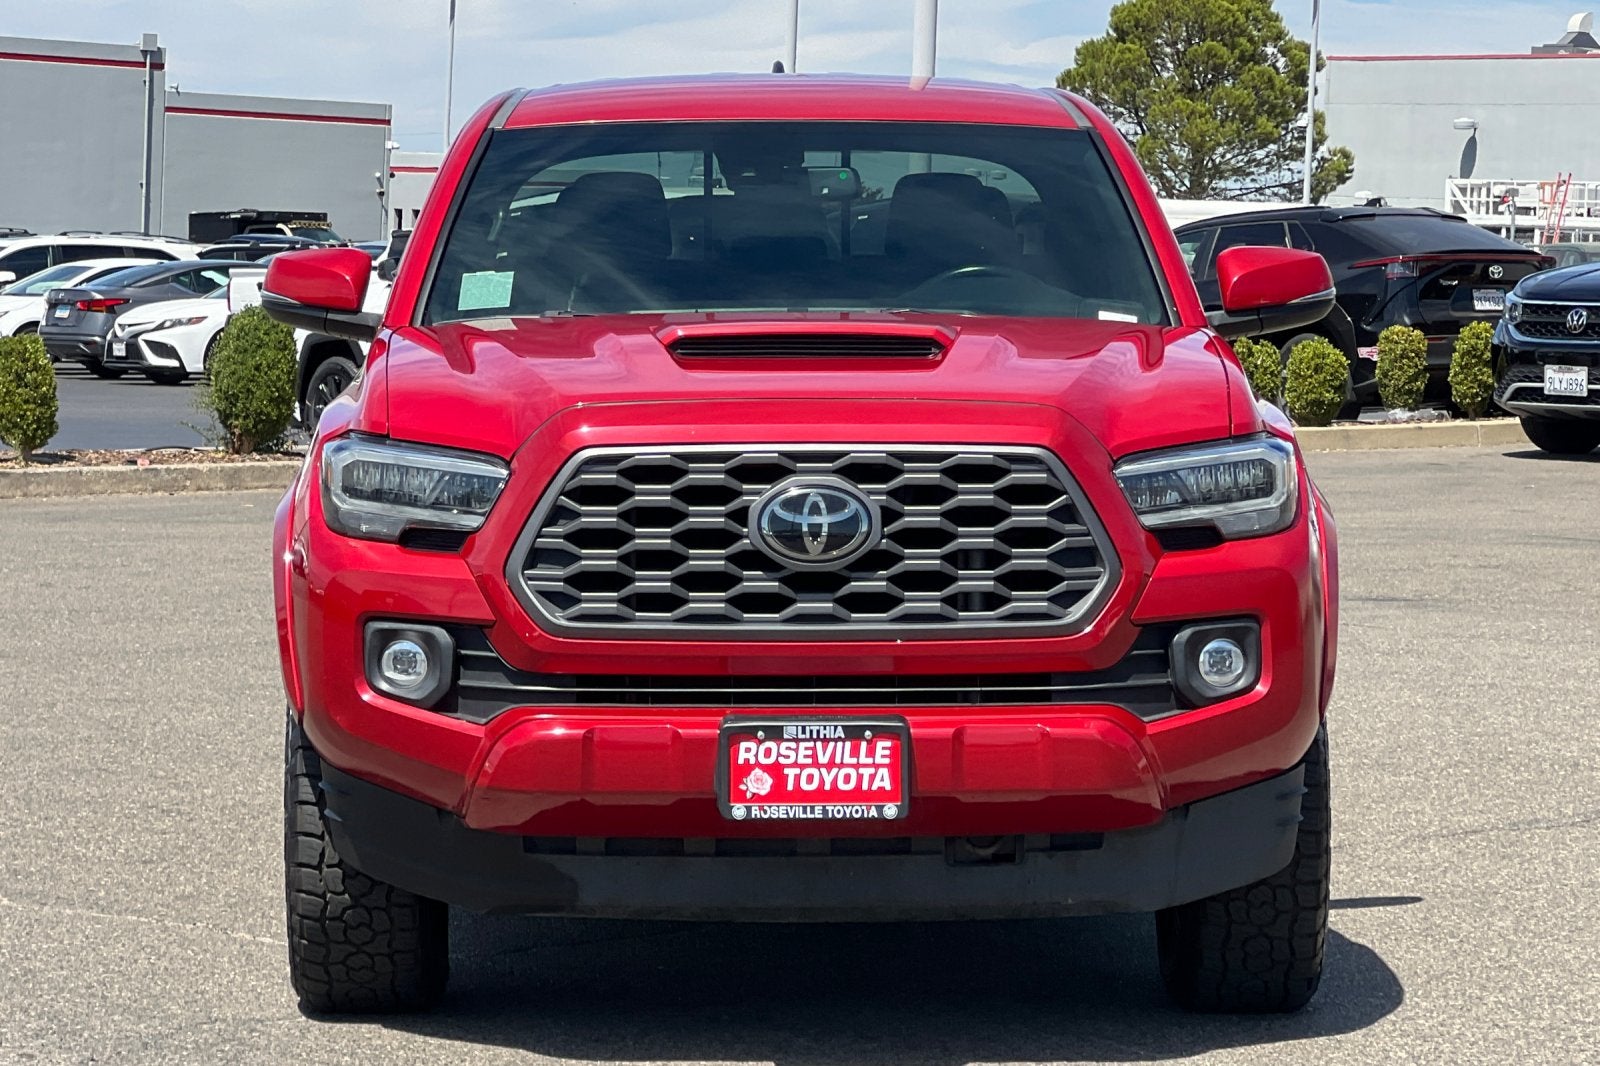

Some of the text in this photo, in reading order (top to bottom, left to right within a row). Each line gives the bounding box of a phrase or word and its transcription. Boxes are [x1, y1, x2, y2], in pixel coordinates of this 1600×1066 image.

[1548, 376, 1584, 391] 9LYJ896
[797, 726, 845, 739] LITHIA
[737, 741, 892, 765] ROSEVILLE
[783, 767, 892, 791] TOYOTA
[751, 805, 878, 819] ROSEVILLE TOYOTA
